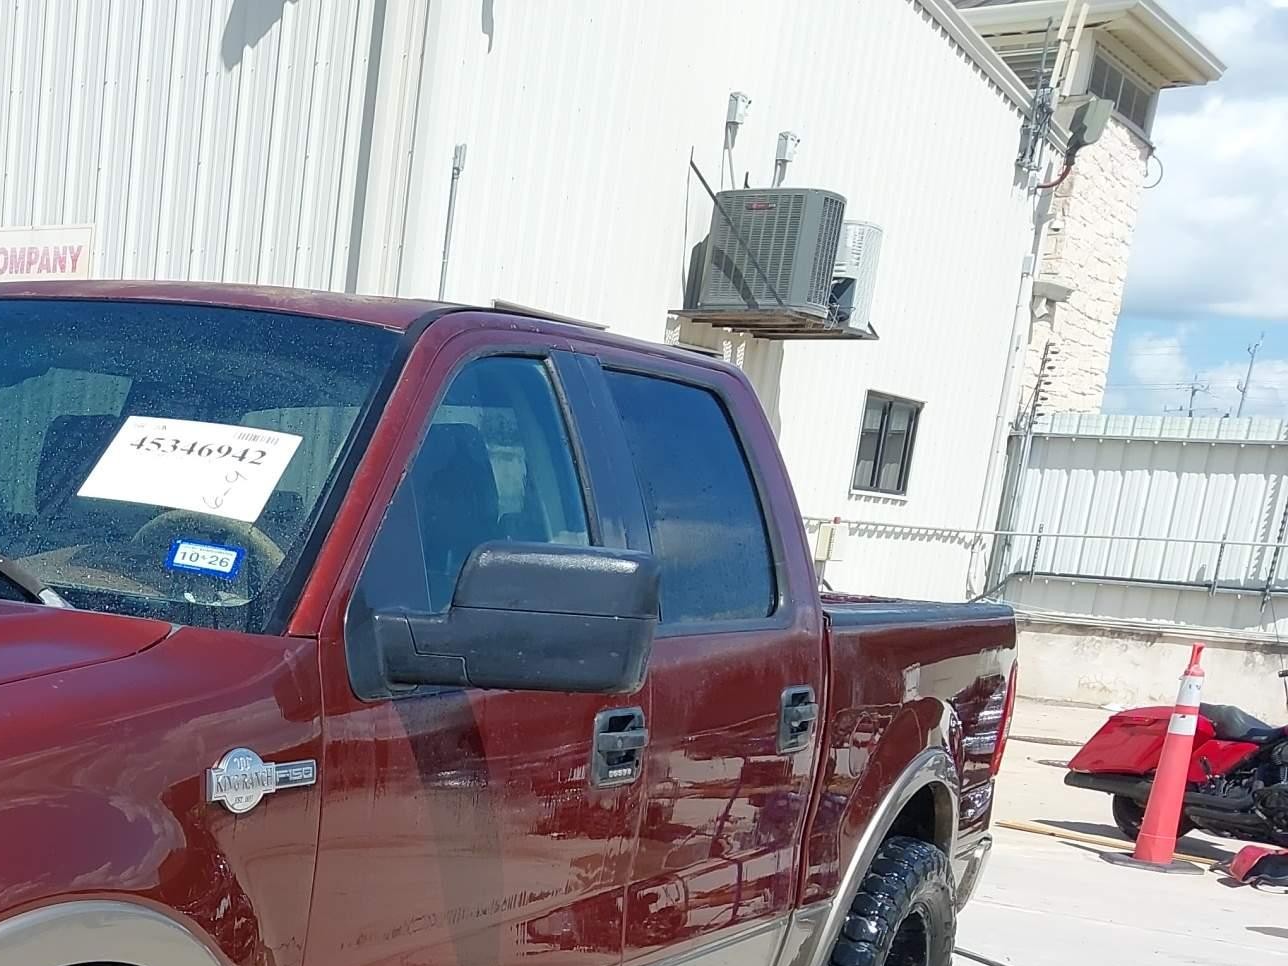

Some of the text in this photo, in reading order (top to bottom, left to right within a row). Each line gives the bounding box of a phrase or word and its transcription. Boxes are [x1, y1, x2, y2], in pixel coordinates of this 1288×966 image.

[130, 435, 267, 465] 45346942
[216, 767, 274, 793] KING RANCH
